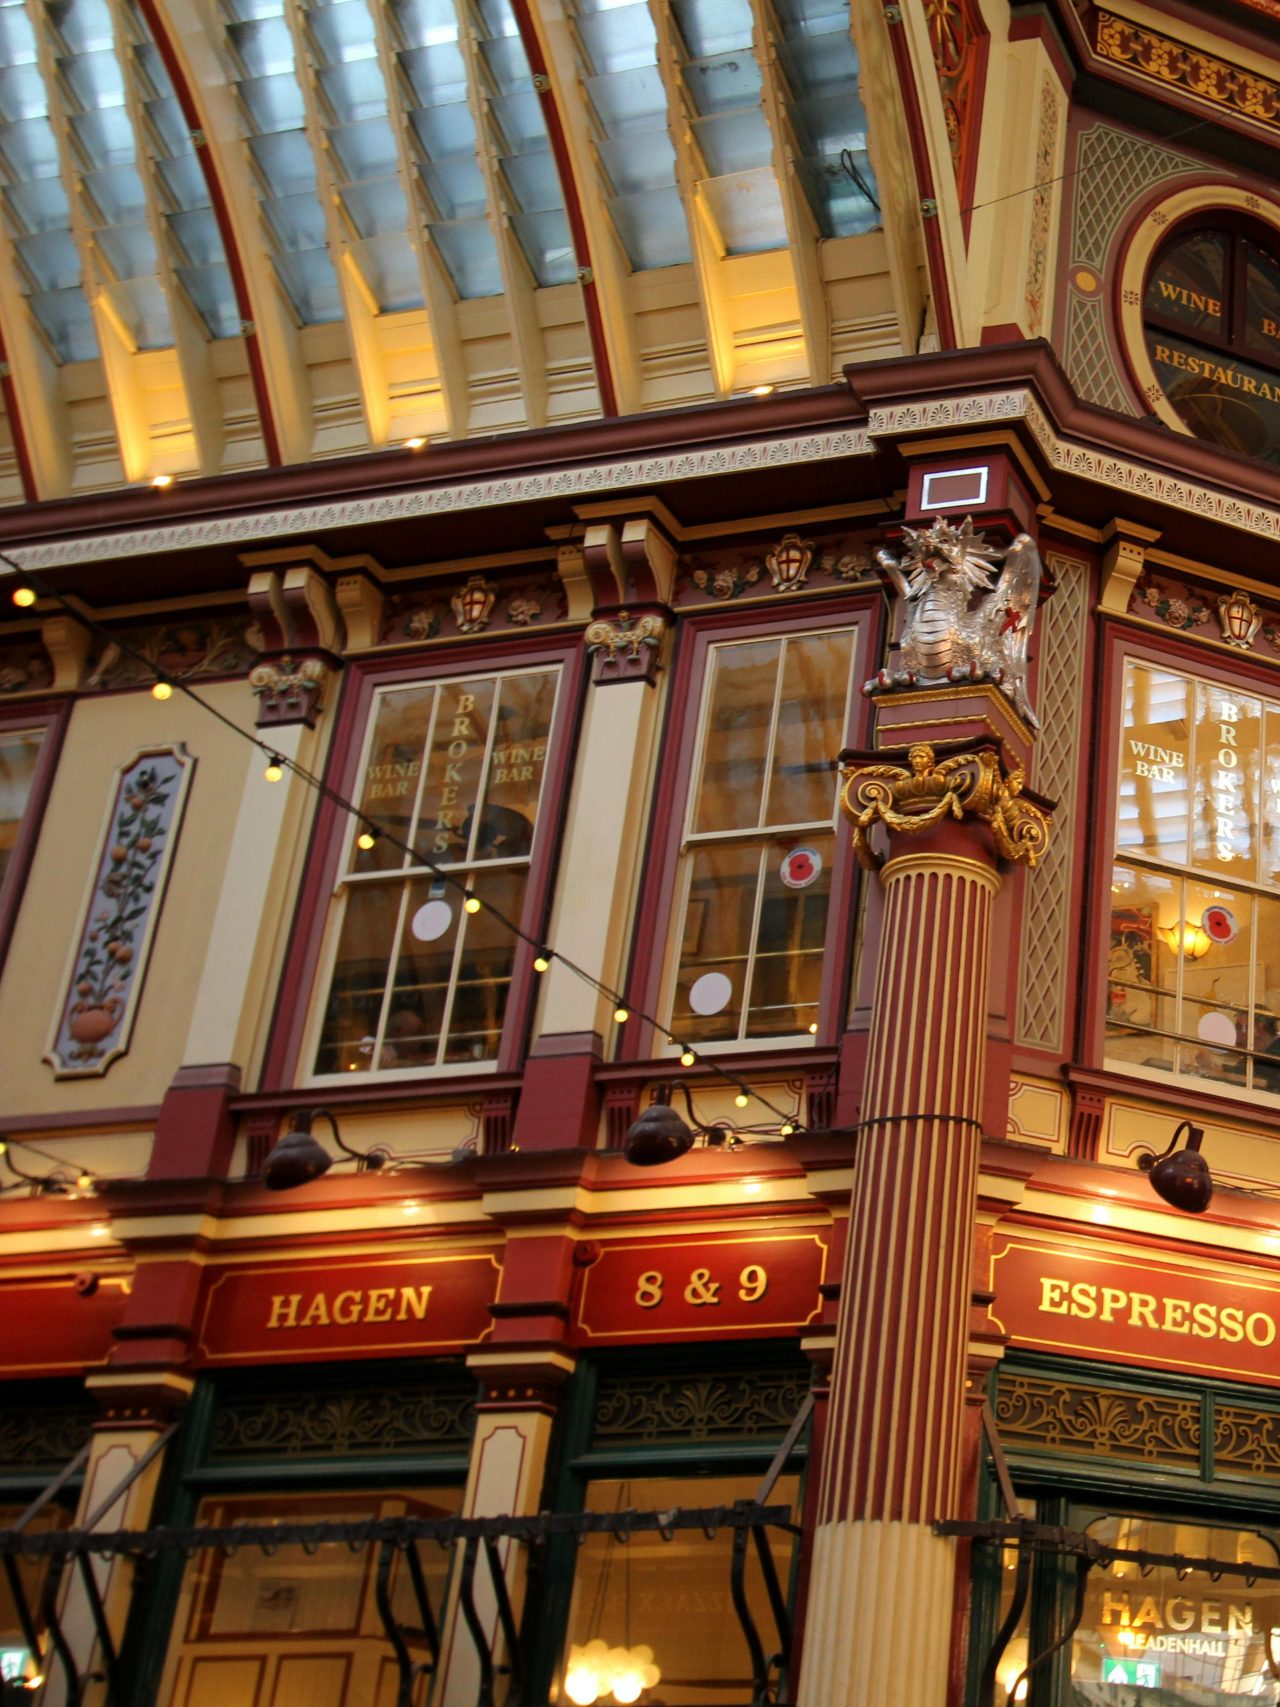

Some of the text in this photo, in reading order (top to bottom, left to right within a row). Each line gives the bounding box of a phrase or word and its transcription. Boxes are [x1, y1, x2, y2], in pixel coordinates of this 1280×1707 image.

[1158, 281, 1222, 317] WINE
[492, 747, 546, 766] WINE
[1129, 740, 1184, 768] WINE
[367, 762, 420, 781] WINE
[433, 694, 475, 854] BROKERS
[495, 766, 534, 784] BAR
[1136, 760, 1175, 785] BAR
[1216, 702, 1238, 862] BROKERS
[370, 781, 409, 800] BAR
[634, 1264, 769, 1308] 8 & 9
[266, 1285, 433, 1330] HAGEN
[1038, 1277, 1276, 1348] ESPRESSO
[1102, 1589, 1253, 1637] HAGEN
[1129, 1634, 1226, 1657] LEADENHALL
